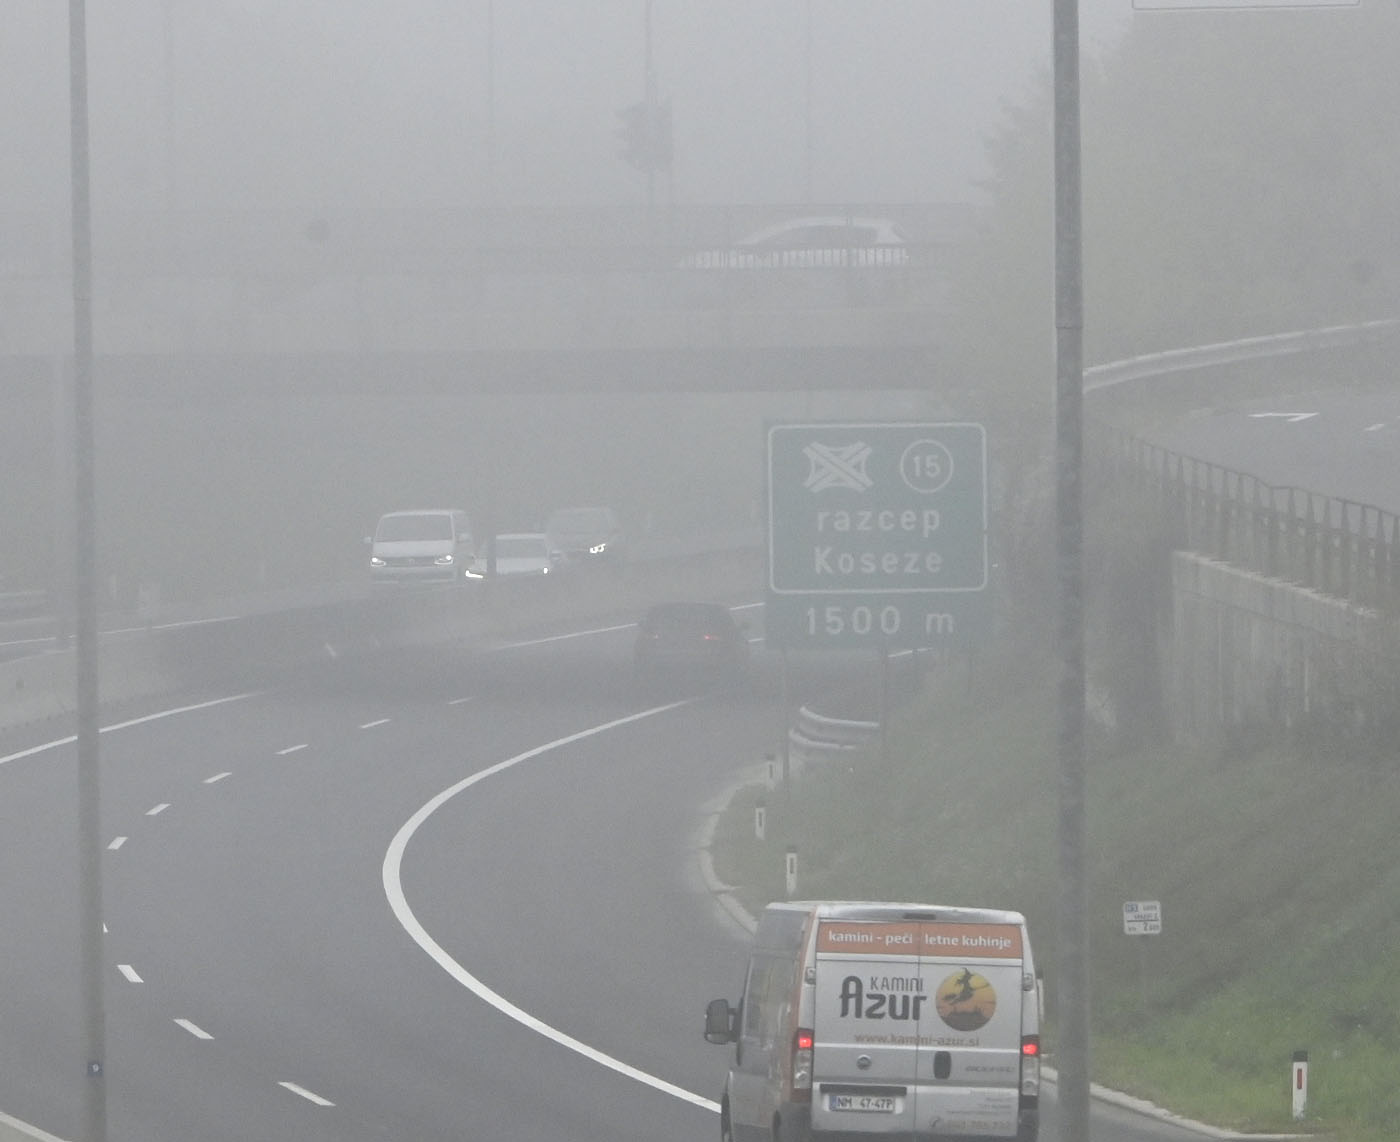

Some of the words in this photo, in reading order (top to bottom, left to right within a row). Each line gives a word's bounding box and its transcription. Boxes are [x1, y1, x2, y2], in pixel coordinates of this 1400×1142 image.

[913, 454, 942, 478] 15
[817, 509, 941, 538] razcep
[814, 546, 944, 575] Koseze
[807, 606, 901, 635] 1500
[925, 612, 954, 634] m
[828, 931, 873, 943] kamini
[885, 932, 913, 946] peči
[925, 933, 959, 946] letne
[962, 935, 1012, 950] kuhinje
[839, 975, 928, 1021] Azur
